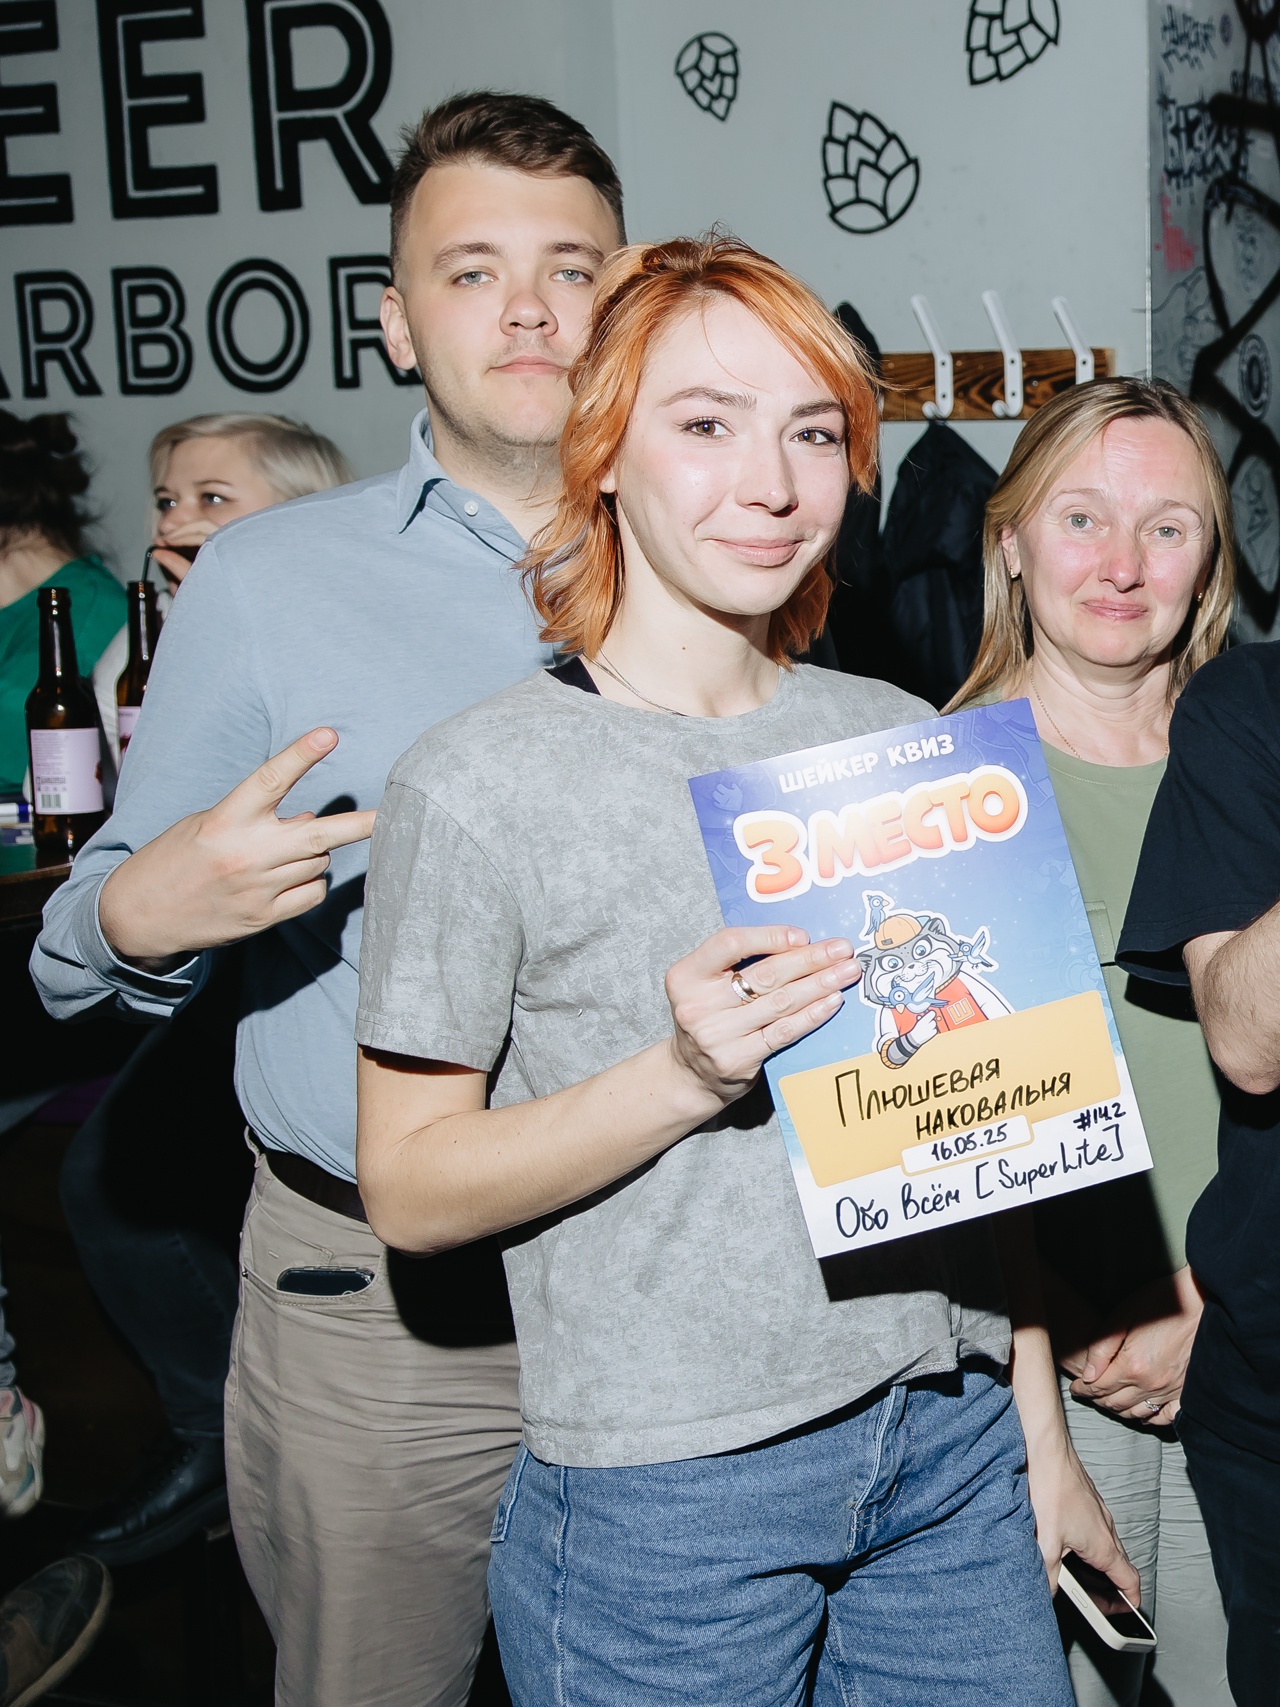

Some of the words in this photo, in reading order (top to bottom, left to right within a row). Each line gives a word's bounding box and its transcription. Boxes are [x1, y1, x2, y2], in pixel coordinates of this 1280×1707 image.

[0, 254, 424, 398] RBOR
[777, 752, 879, 794] ШЕЙКЕР
[886, 734, 955, 767] КВИЗ
[739, 816, 806, 898] 3
[813, 770, 1022, 880] МЕСТО
[915, 1072, 1071, 1140] НАКОВАЛЬНЯ
[931, 1122, 1007, 1161] 16.05.25
